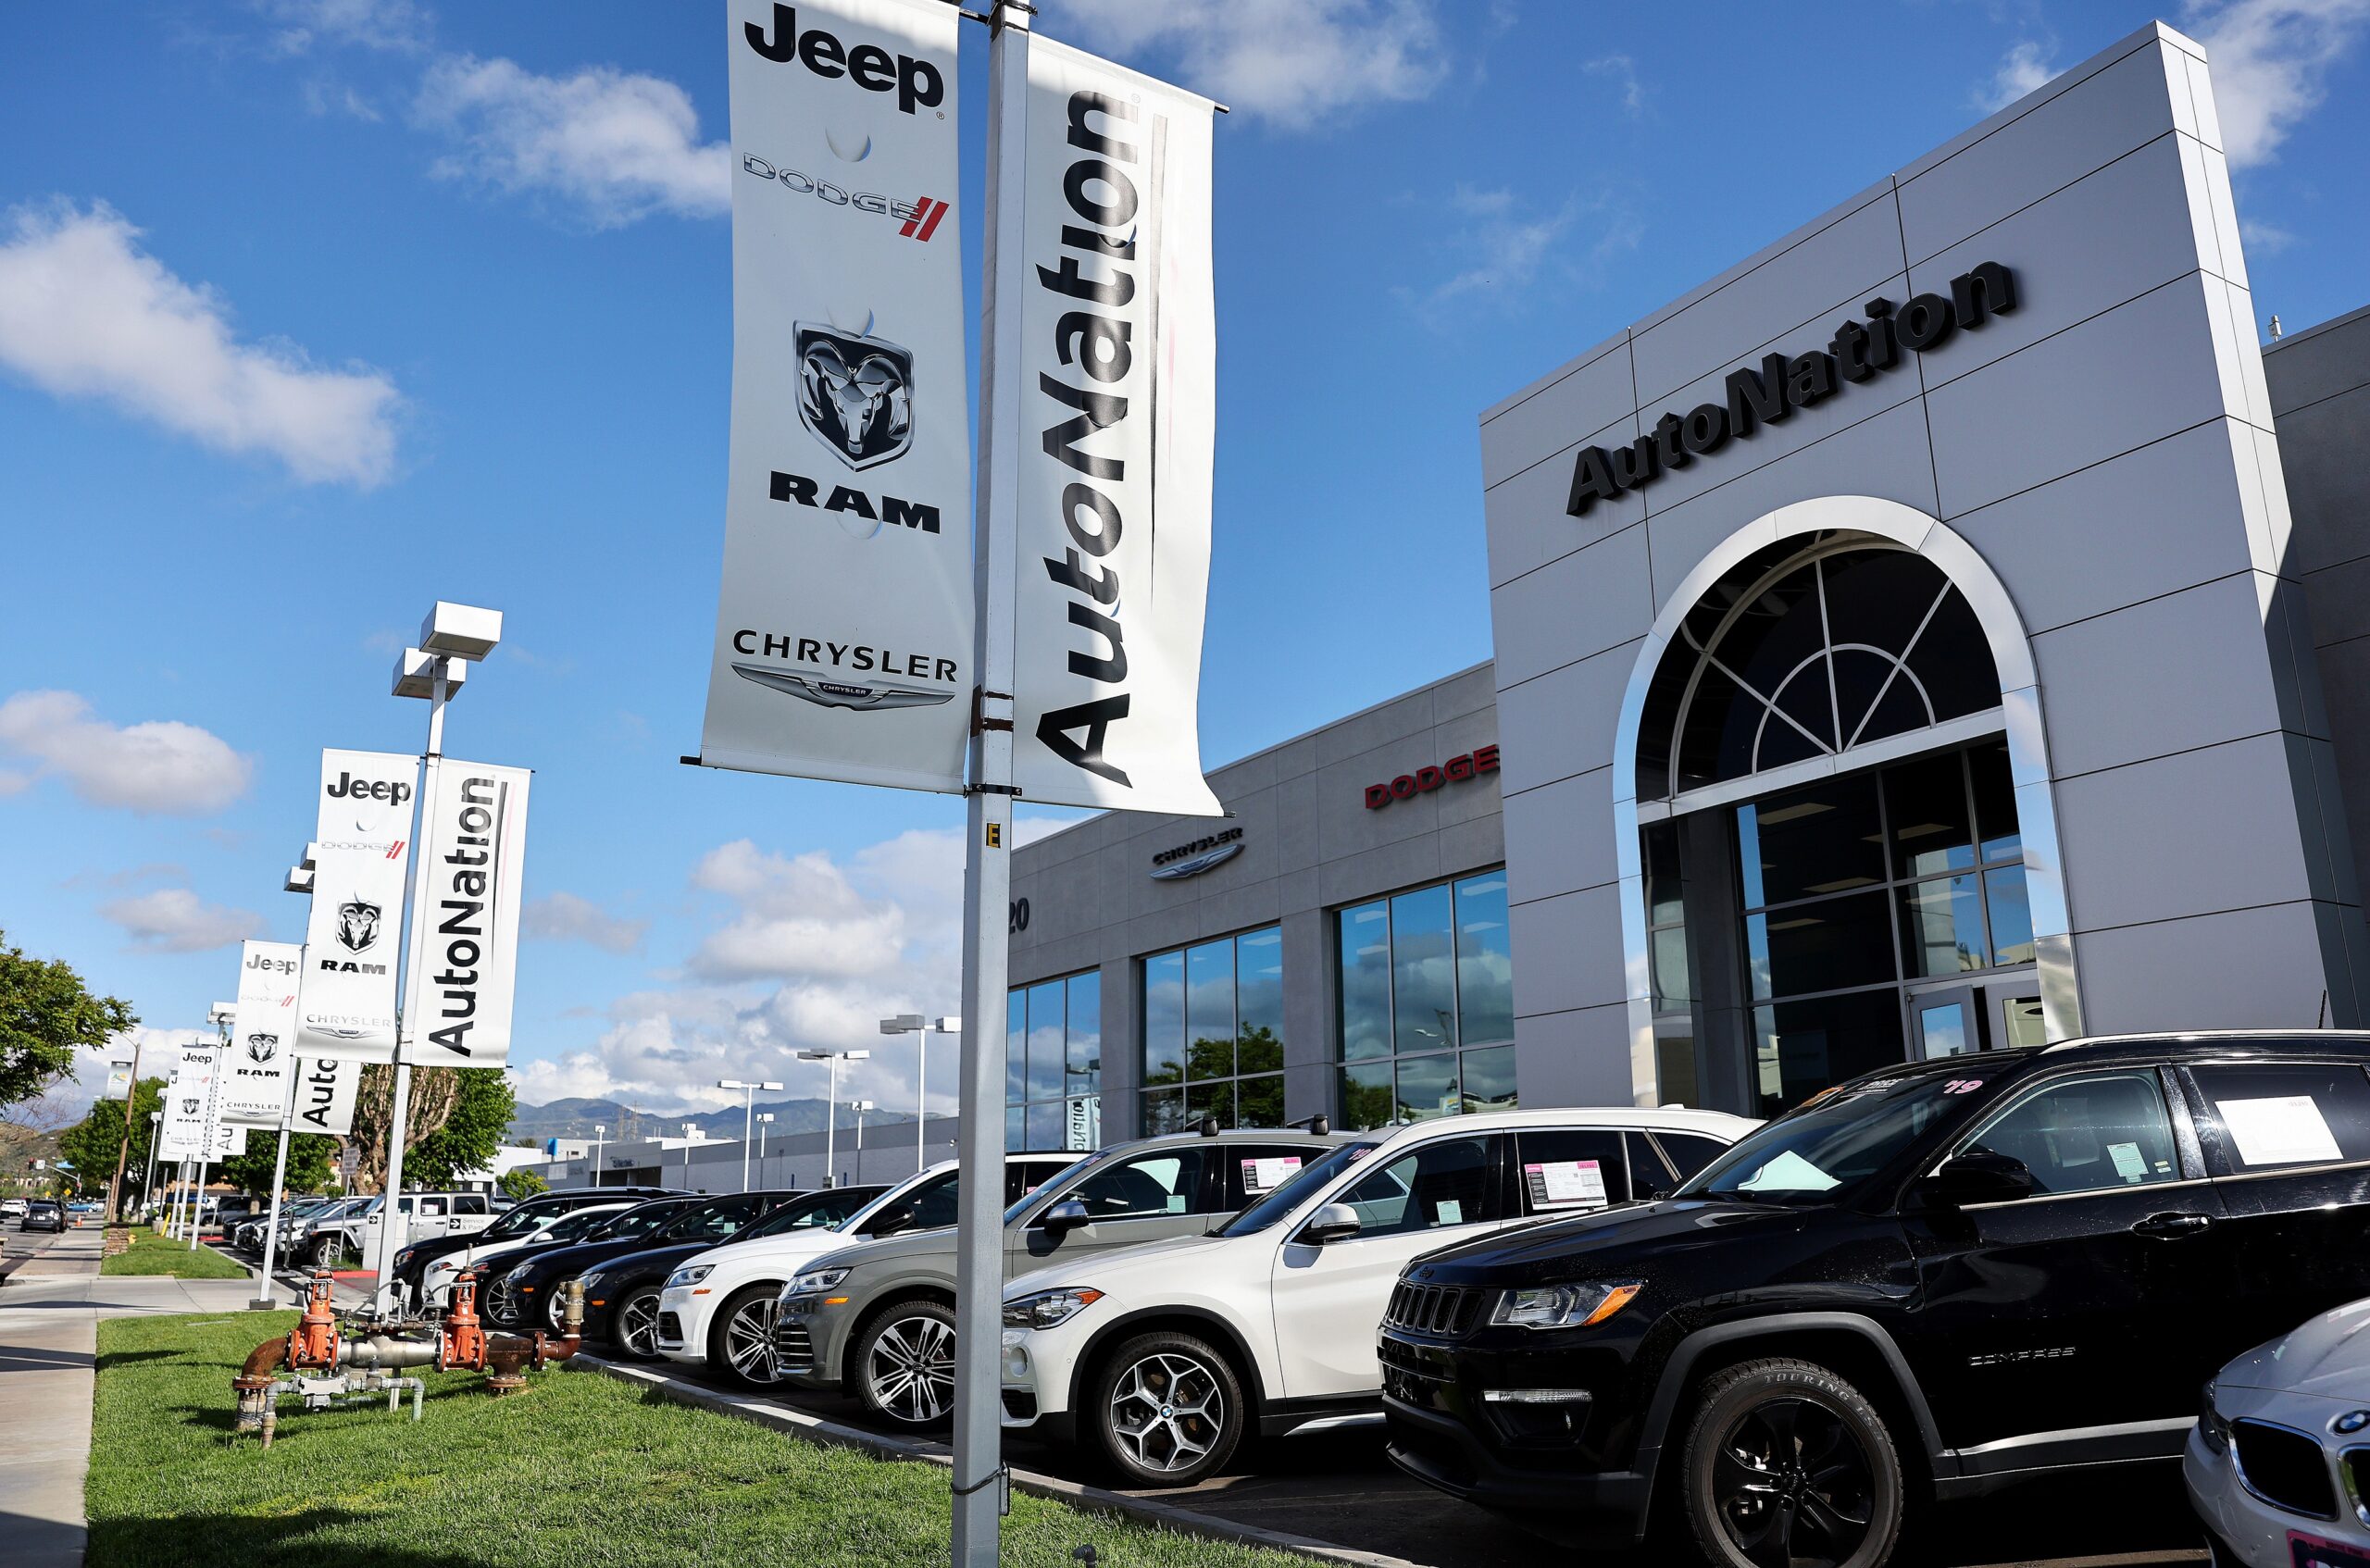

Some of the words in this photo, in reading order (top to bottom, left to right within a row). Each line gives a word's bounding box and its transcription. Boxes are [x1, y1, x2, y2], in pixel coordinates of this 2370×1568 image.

[744, 2, 944, 116] Jeep
[742, 152, 922, 225] DODGE
[1565, 260, 2016, 516] AutoNation
[1034, 89, 1140, 790] AutoNation
[769, 470, 941, 535] RAM
[732, 629, 958, 683] CHRYSLER
[822, 684, 867, 695] CHRYSLER
[327, 772, 410, 806] Jeep
[1365, 743, 1500, 810] DODGE
[988, 824, 999, 848] E
[1153, 827, 1243, 865] CHRYSLER
[429, 778, 494, 1058] AutoNation
[246, 954, 298, 975] Jeep
[320, 959, 386, 975] RAM
[306, 1013, 392, 1027] CHRYSLER
[182, 1052, 212, 1064] Jeep
[237, 1068, 280, 1077] RAM
[226, 1101, 281, 1110] CHRYSLER
[1967, 1347, 2076, 1366] COMPASS
[1764, 1373, 1849, 1401] TOURING
